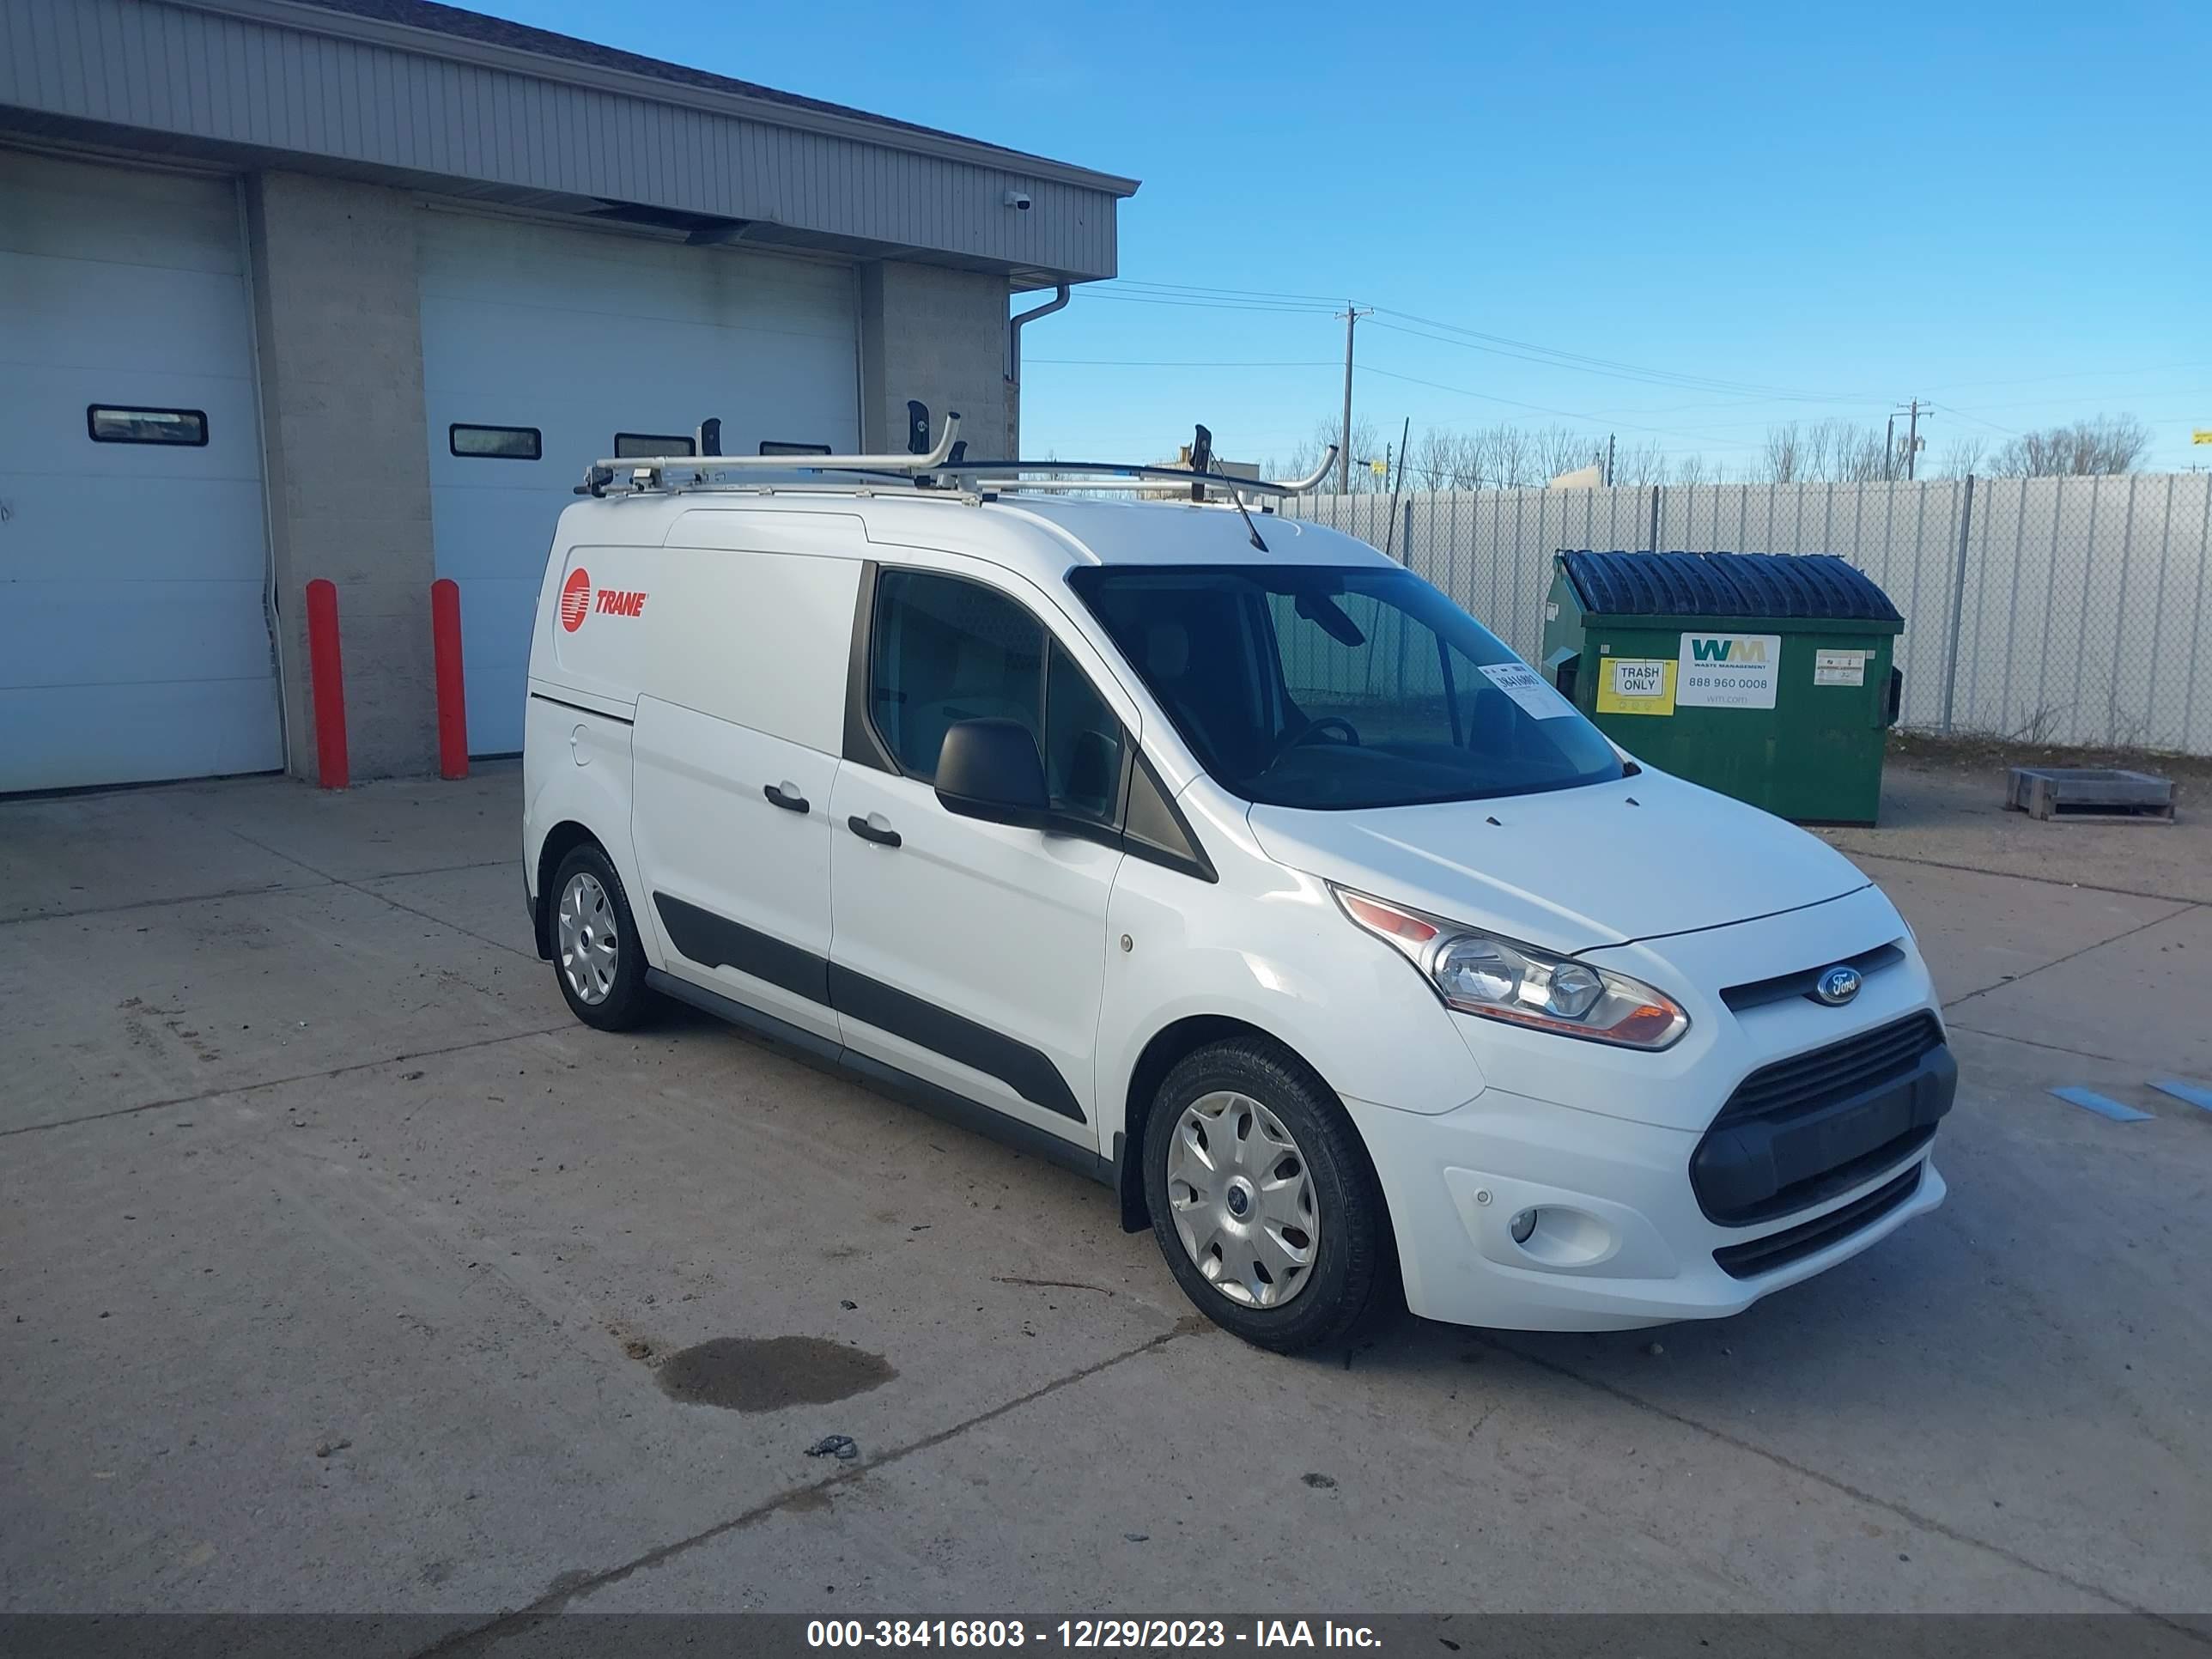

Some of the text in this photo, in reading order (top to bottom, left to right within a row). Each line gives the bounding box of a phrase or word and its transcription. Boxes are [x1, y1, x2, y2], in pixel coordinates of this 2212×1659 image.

[595, 589, 647, 617] TRANE
[1692, 639, 1766, 662] WM
[1620, 667, 1659, 678] TRASH
[1624, 679, 1656, 690] ONLY
[1689, 677, 1767, 689] 888 960 0008
[1706, 695, 1747, 704] wm.com
[1832, 973, 1856, 995] Ford
